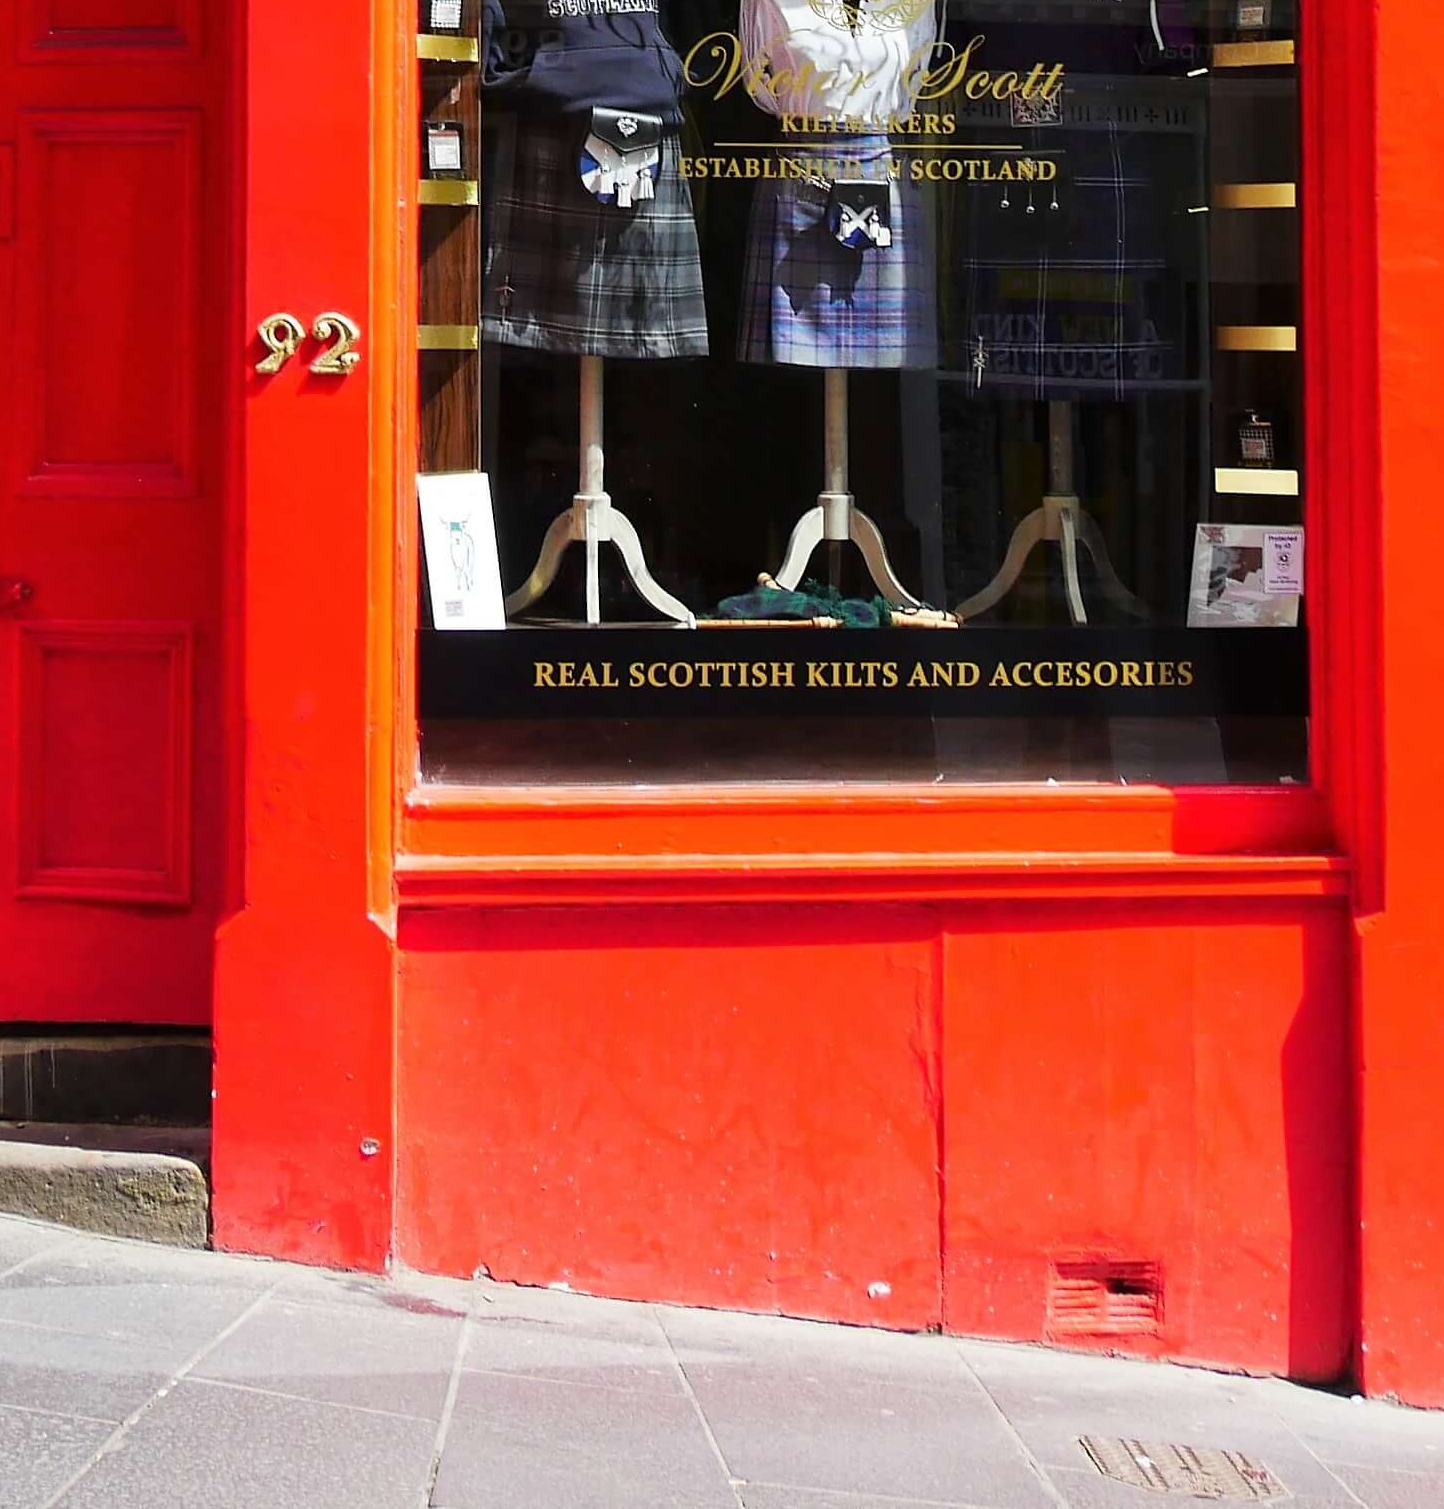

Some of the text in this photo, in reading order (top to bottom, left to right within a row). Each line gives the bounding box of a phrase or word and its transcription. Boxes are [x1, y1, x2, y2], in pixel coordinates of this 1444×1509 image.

[684, 31, 1066, 110] Victor Scott
[780, 111, 957, 135] KILTMAKERS
[680, 157, 862, 180] ESTABLISHED
[910, 158, 1057, 182] SCOTLAND
[255, 312, 362, 374] 92
[533, 661, 1194, 688] REAL SCOTTISH KILTS AND ACCESORIES
